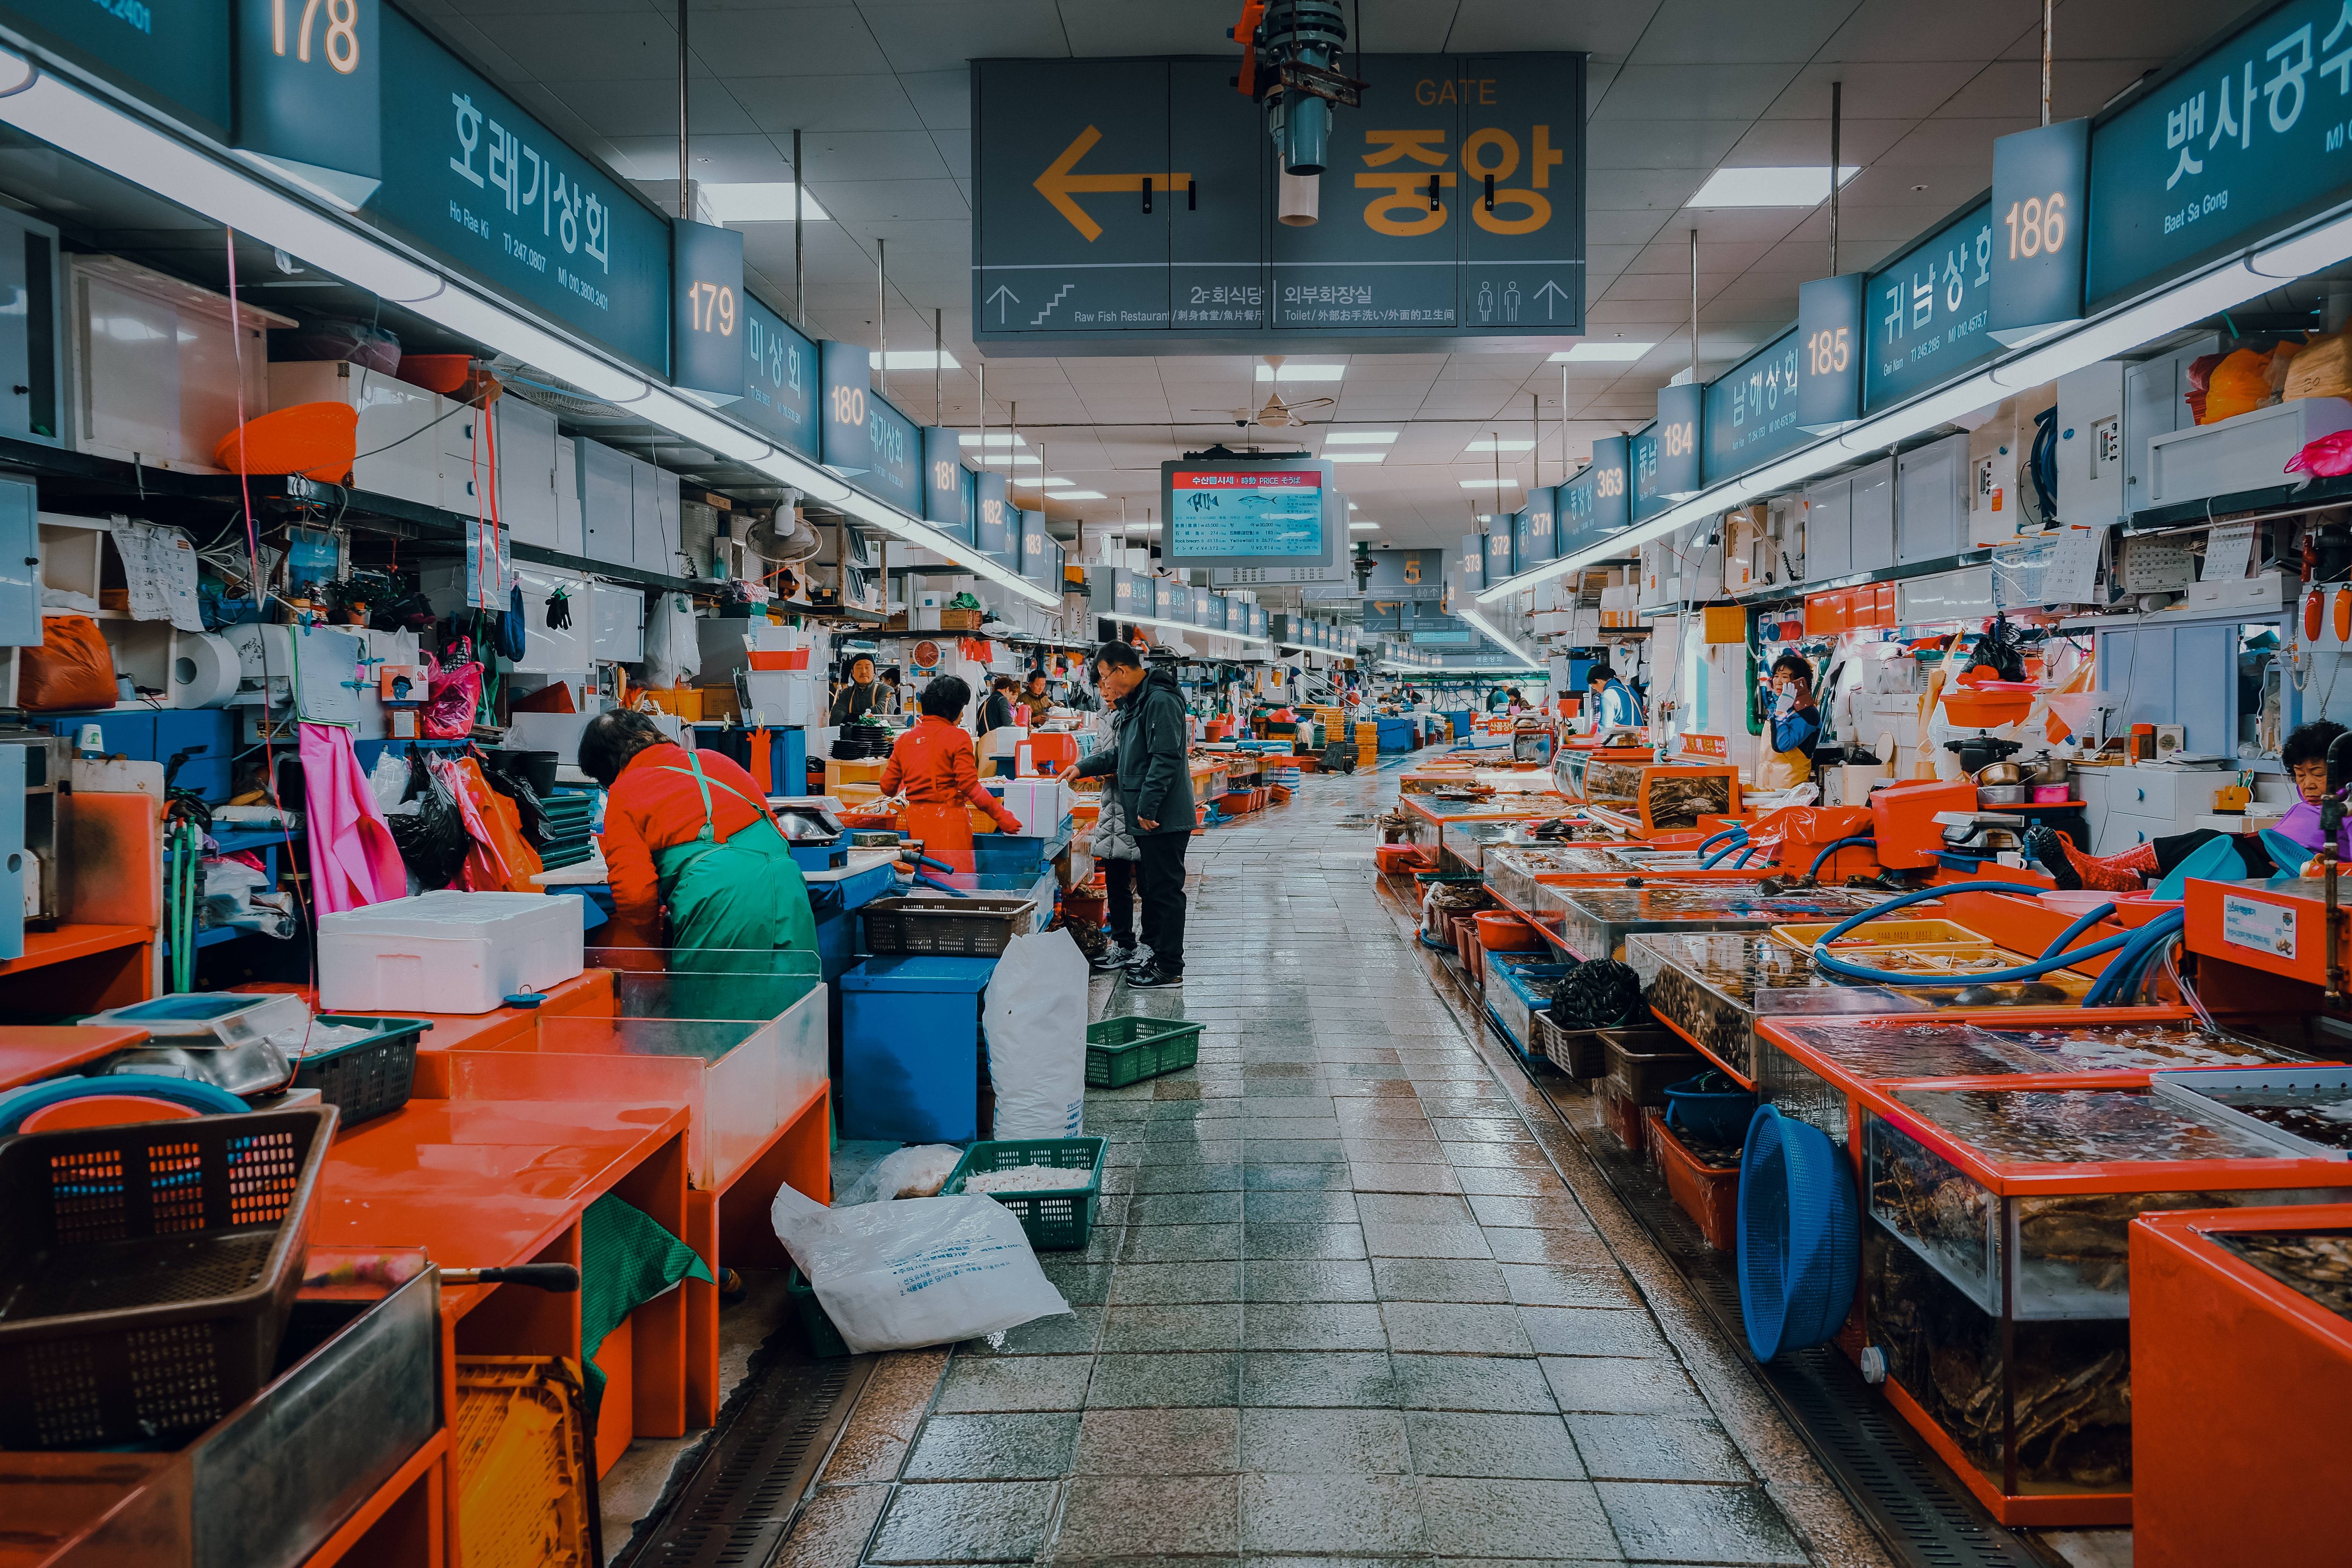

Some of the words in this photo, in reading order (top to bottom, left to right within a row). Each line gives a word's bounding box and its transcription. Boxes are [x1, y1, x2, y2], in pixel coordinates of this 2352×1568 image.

[1415, 79, 1496, 105] GATE
[450, 93, 608, 274] 호래기상회
[1354, 125, 1563, 236] 중앙
[450, 200, 462, 224] Ho
[464, 209, 478, 233] Rae
[481, 219, 488, 239] Ki
[2164, 213, 2185, 235] Baet
[2188, 203, 2200, 223] Sa
[2203, 189, 2228, 215] Gong
[2005, 191, 2066, 260] 186
[514, 240, 546, 273] 247.0807
[569, 273, 608, 311] 010.3800.2401
[1284, 286, 1372, 304] 외부화장실
[688, 280, 735, 336] 179
[1075, 311, 1093, 322] Raw
[1098, 311, 1116, 322] Fish
[1808, 328, 1848, 375] 185
[1883, 361, 1892, 377] Gwi
[1893, 358, 1903, 372] Nam
[1733, 348, 1798, 428] 남해상회
[832, 386, 864, 426] 180
[870, 409, 903, 469] 래기상회
[1664, 421, 1693, 457] 184
[935, 461, 955, 491] 181
[1192, 476, 1234, 485] 수산물시세
[1597, 468, 1623, 498] 363
[983, 500, 1002, 524] 182
[1532, 513, 1552, 536] 371
[1026, 534, 1041, 554] 183
[1491, 535, 1510, 556] 372
[1404, 561, 1422, 584] 5
[1465, 554, 1481, 573] 373
[1117, 583, 1130, 598] 209
[1133, 581, 1146, 600] 일상회
[1158, 591, 1168, 605] 210
[1228, 609, 1237, 620] 212
[1250, 614, 1259, 625] 213
